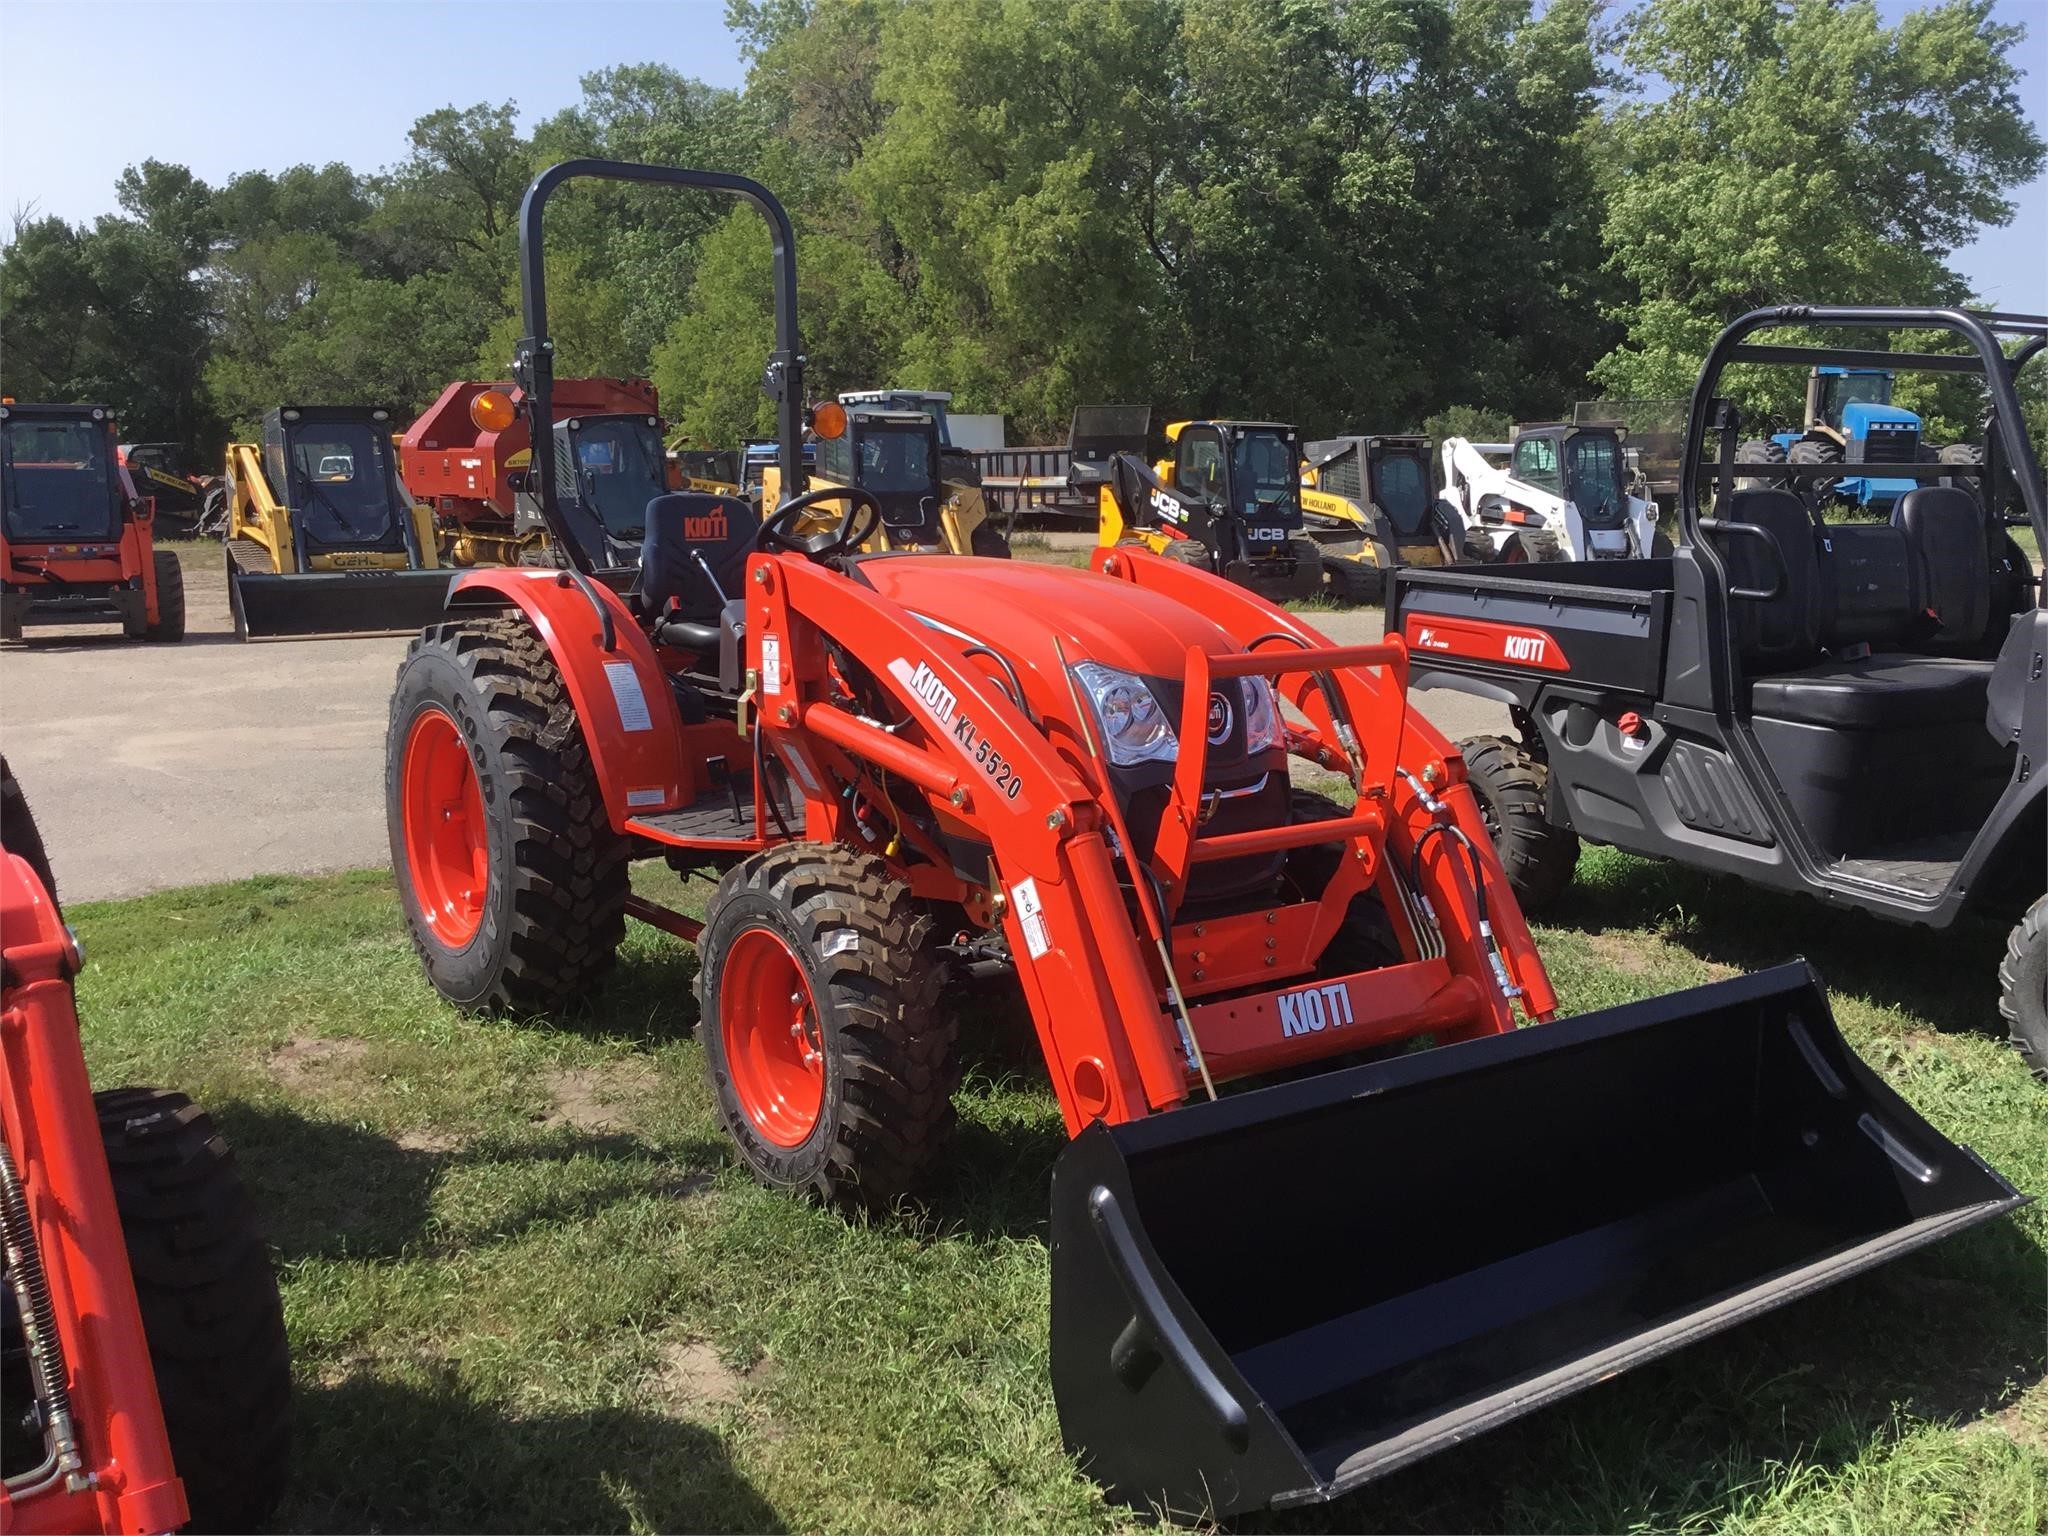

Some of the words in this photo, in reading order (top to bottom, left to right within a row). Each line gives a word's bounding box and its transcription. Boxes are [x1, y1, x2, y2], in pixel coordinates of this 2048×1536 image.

[1151, 489, 1180, 518] JCB
[1309, 499, 1336, 512] HOLLAND
[685, 517, 728, 538] KIOTI
[1248, 528, 1285, 541] JCB
[1504, 635, 1546, 662] KIOTI
[910, 659, 958, 725] KIOTI
[1277, 983, 1354, 1038] KIOTI
